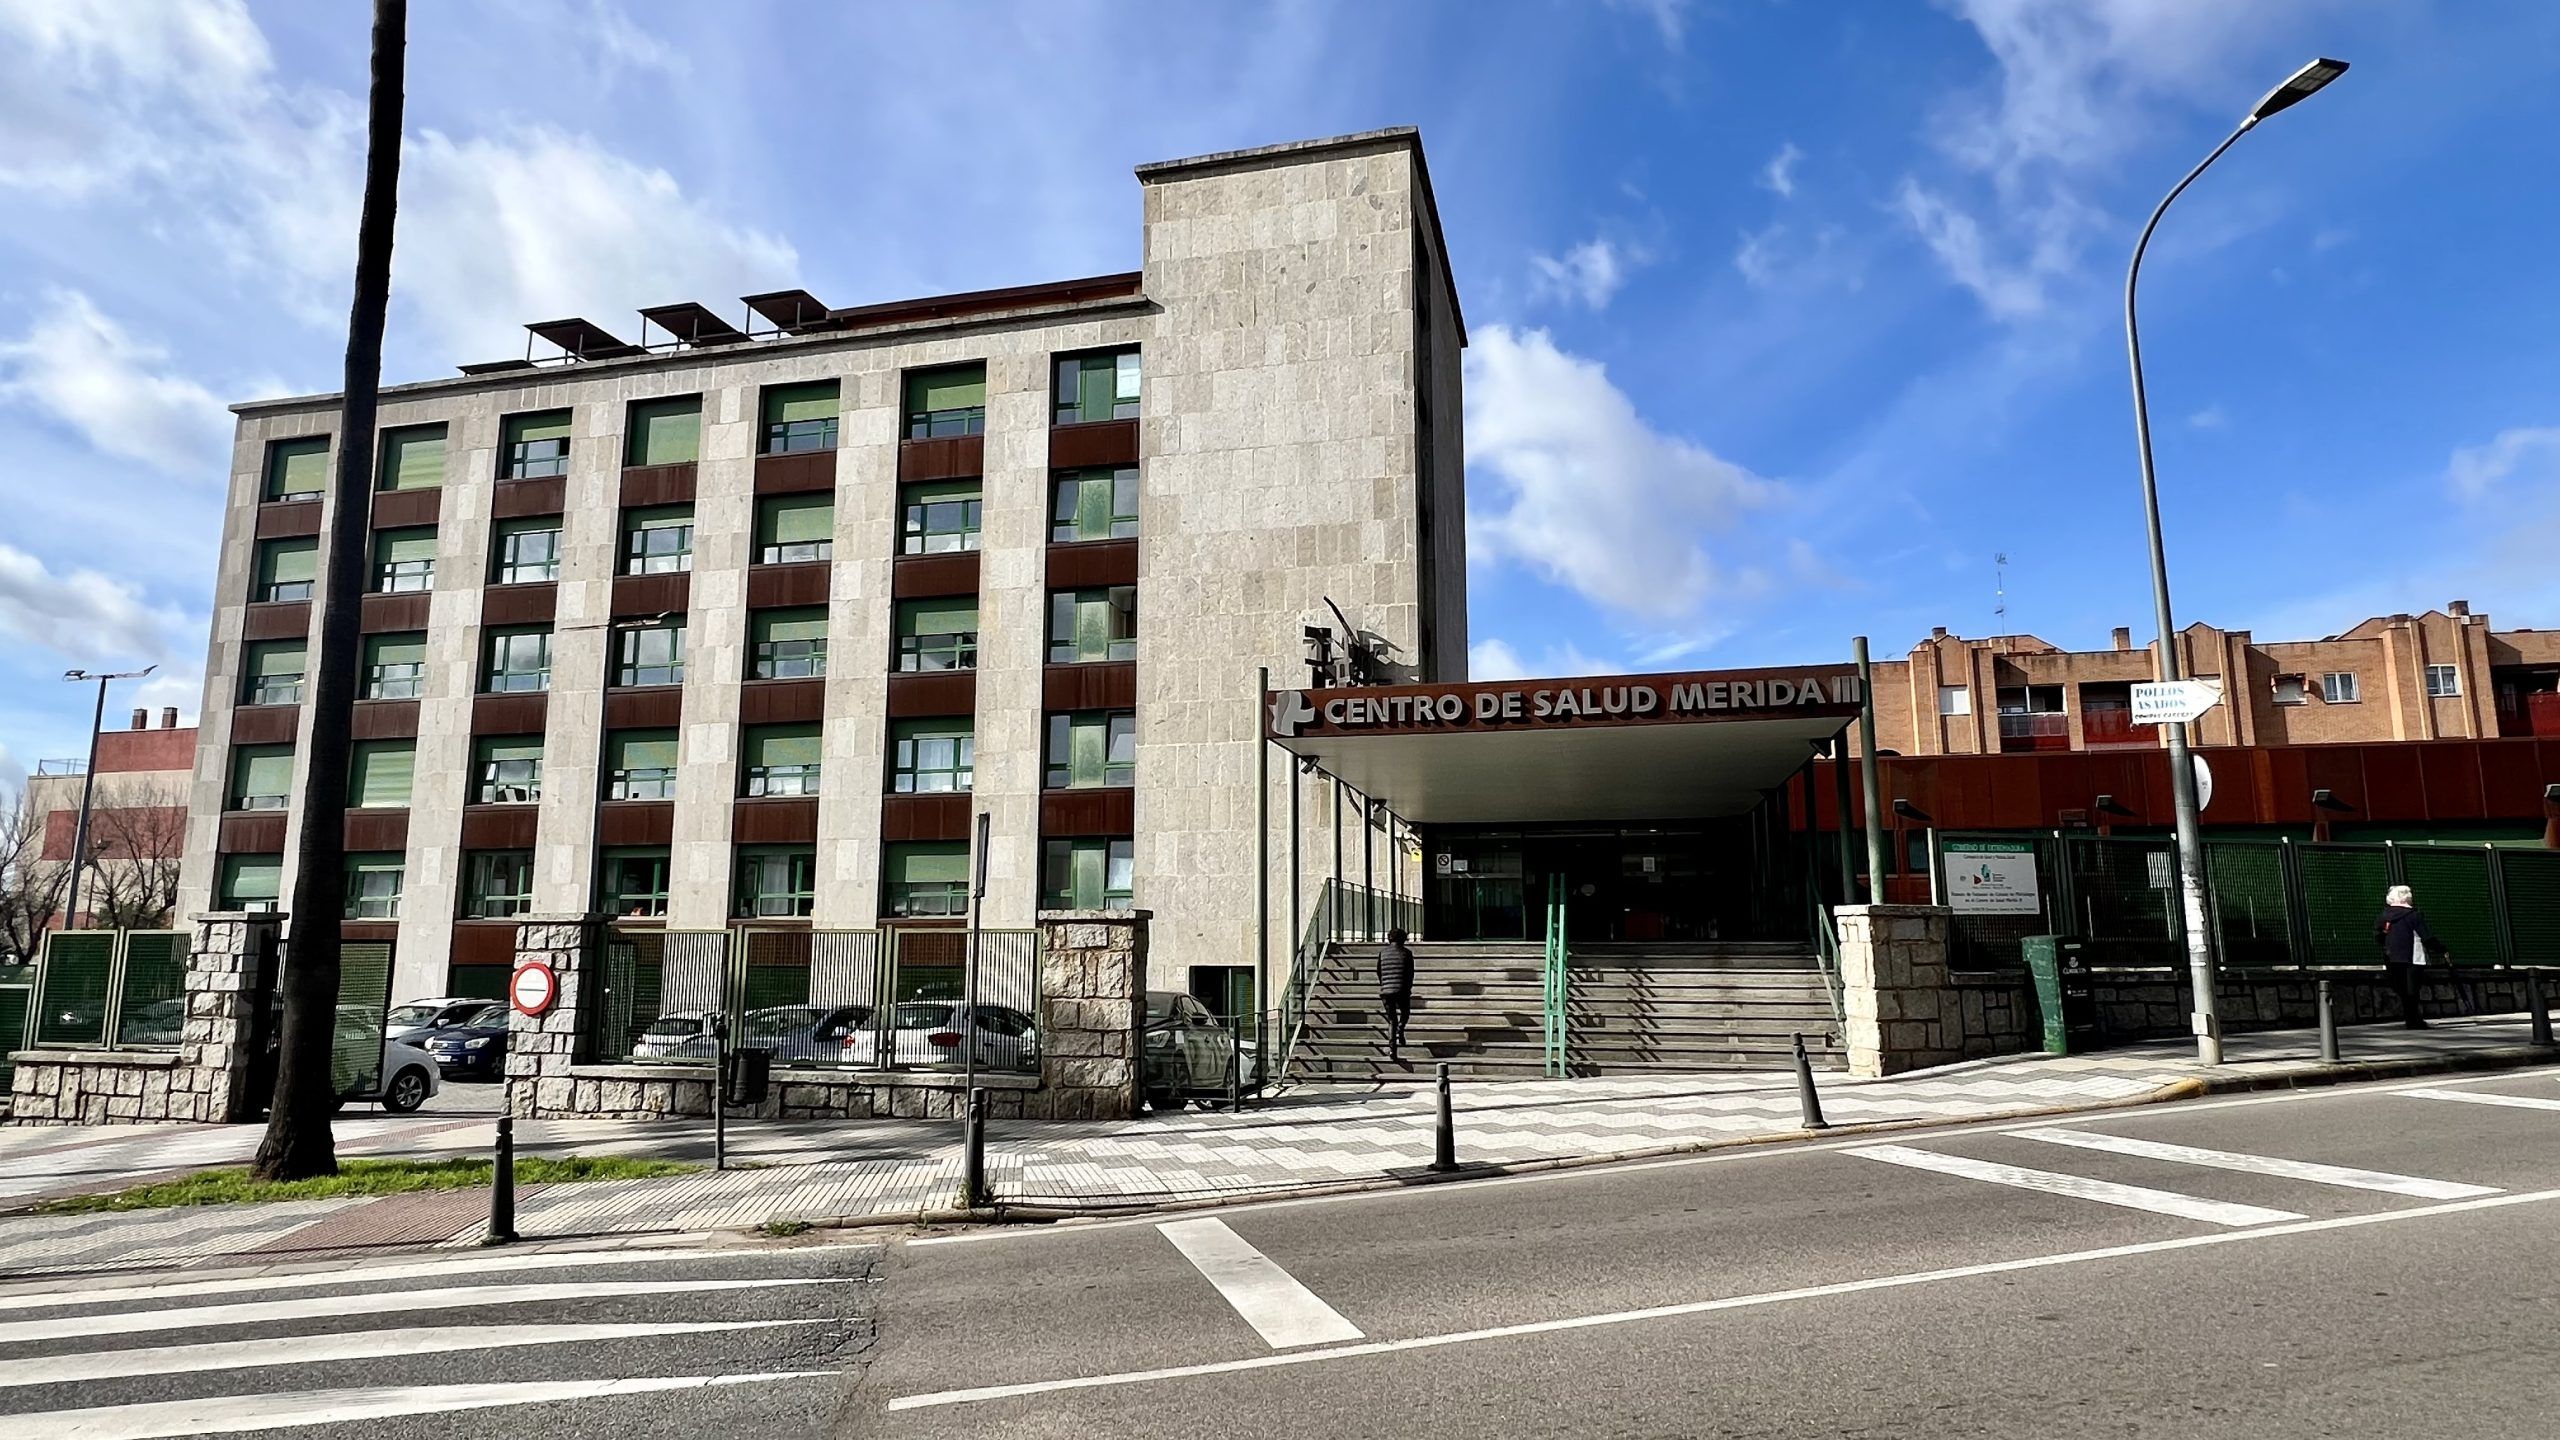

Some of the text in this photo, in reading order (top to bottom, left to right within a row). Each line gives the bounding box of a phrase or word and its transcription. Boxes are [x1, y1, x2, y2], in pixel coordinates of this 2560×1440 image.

[2136, 688, 2184, 698] POLLOS
[1324, 675, 1861, 724] CENTRO DE SALUD MERIDA III
[2138, 700, 2186, 710] ASADOS
